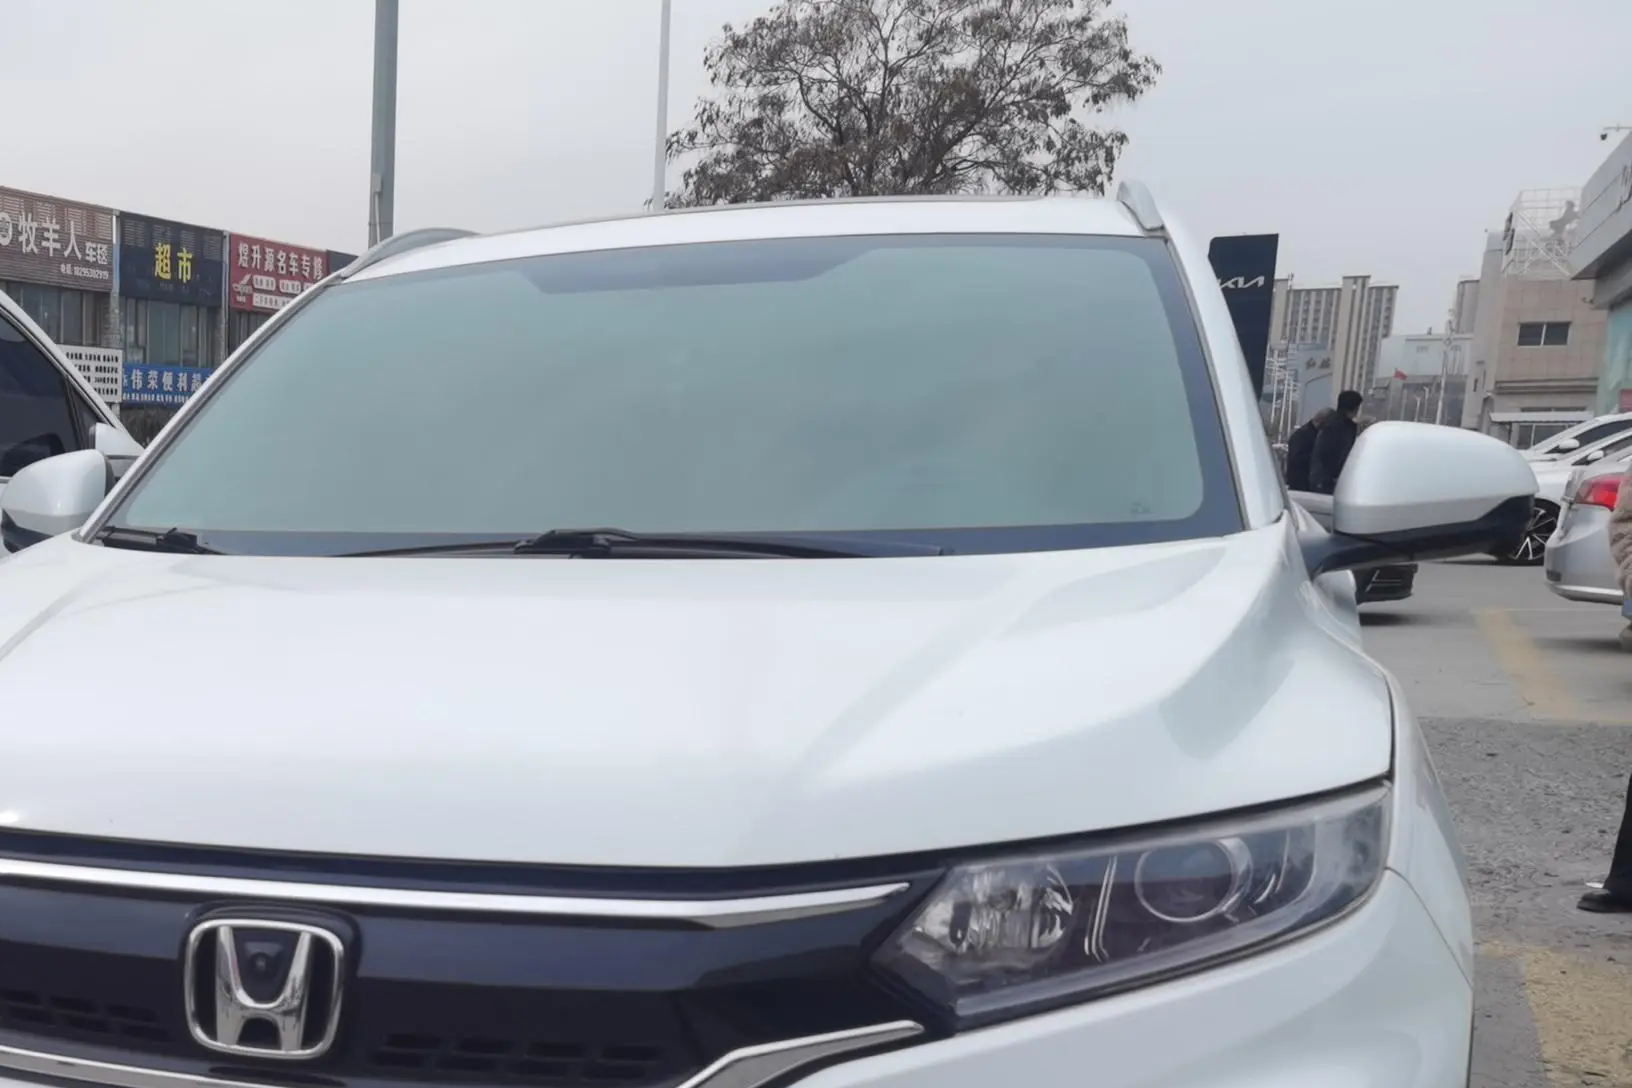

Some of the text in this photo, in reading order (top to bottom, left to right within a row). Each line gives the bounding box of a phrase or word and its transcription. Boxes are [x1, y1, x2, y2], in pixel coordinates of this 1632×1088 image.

[18, 212, 82, 260] 牧羊人
[154, 242, 193, 284] 超市
